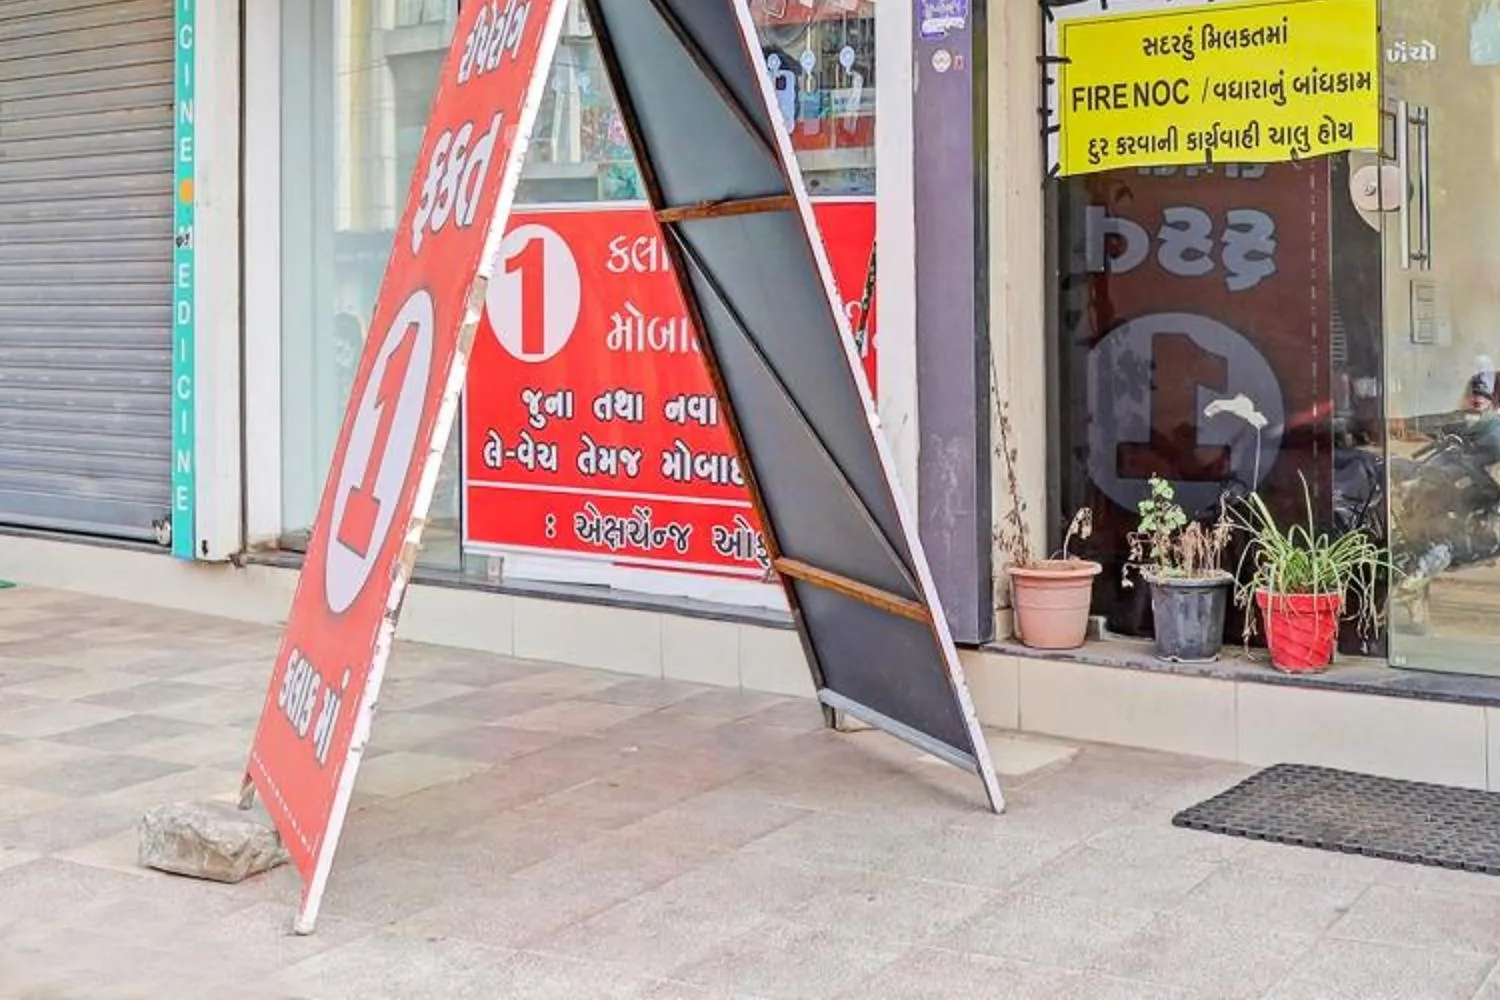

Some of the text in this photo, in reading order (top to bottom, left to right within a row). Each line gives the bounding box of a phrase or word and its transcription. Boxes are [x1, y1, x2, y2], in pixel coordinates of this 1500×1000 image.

[1201, 16, 1288, 51] મિલકતમાં
[1072, 83, 1128, 112] FIRE
[1133, 78, 1190, 109] NOC
[1292, 66, 1372, 96] બાંધકામ
[1116, 126, 1178, 155] કરવાની
[1187, 120, 1260, 152] કાર્યવાહી
[1268, 122, 1311, 152] ચાલુ
[1317, 114, 1354, 143] હોય
[411, 110, 503, 256] ફકત
[505, 236, 546, 355] 1
[177, 226, 192, 511] MEDICINE
[337, 321, 420, 560] 1
[522, 387, 718, 429] જુના તથા નવા
[577, 433, 642, 478] તેમજ
[278, 646, 318, 739] કલાક
